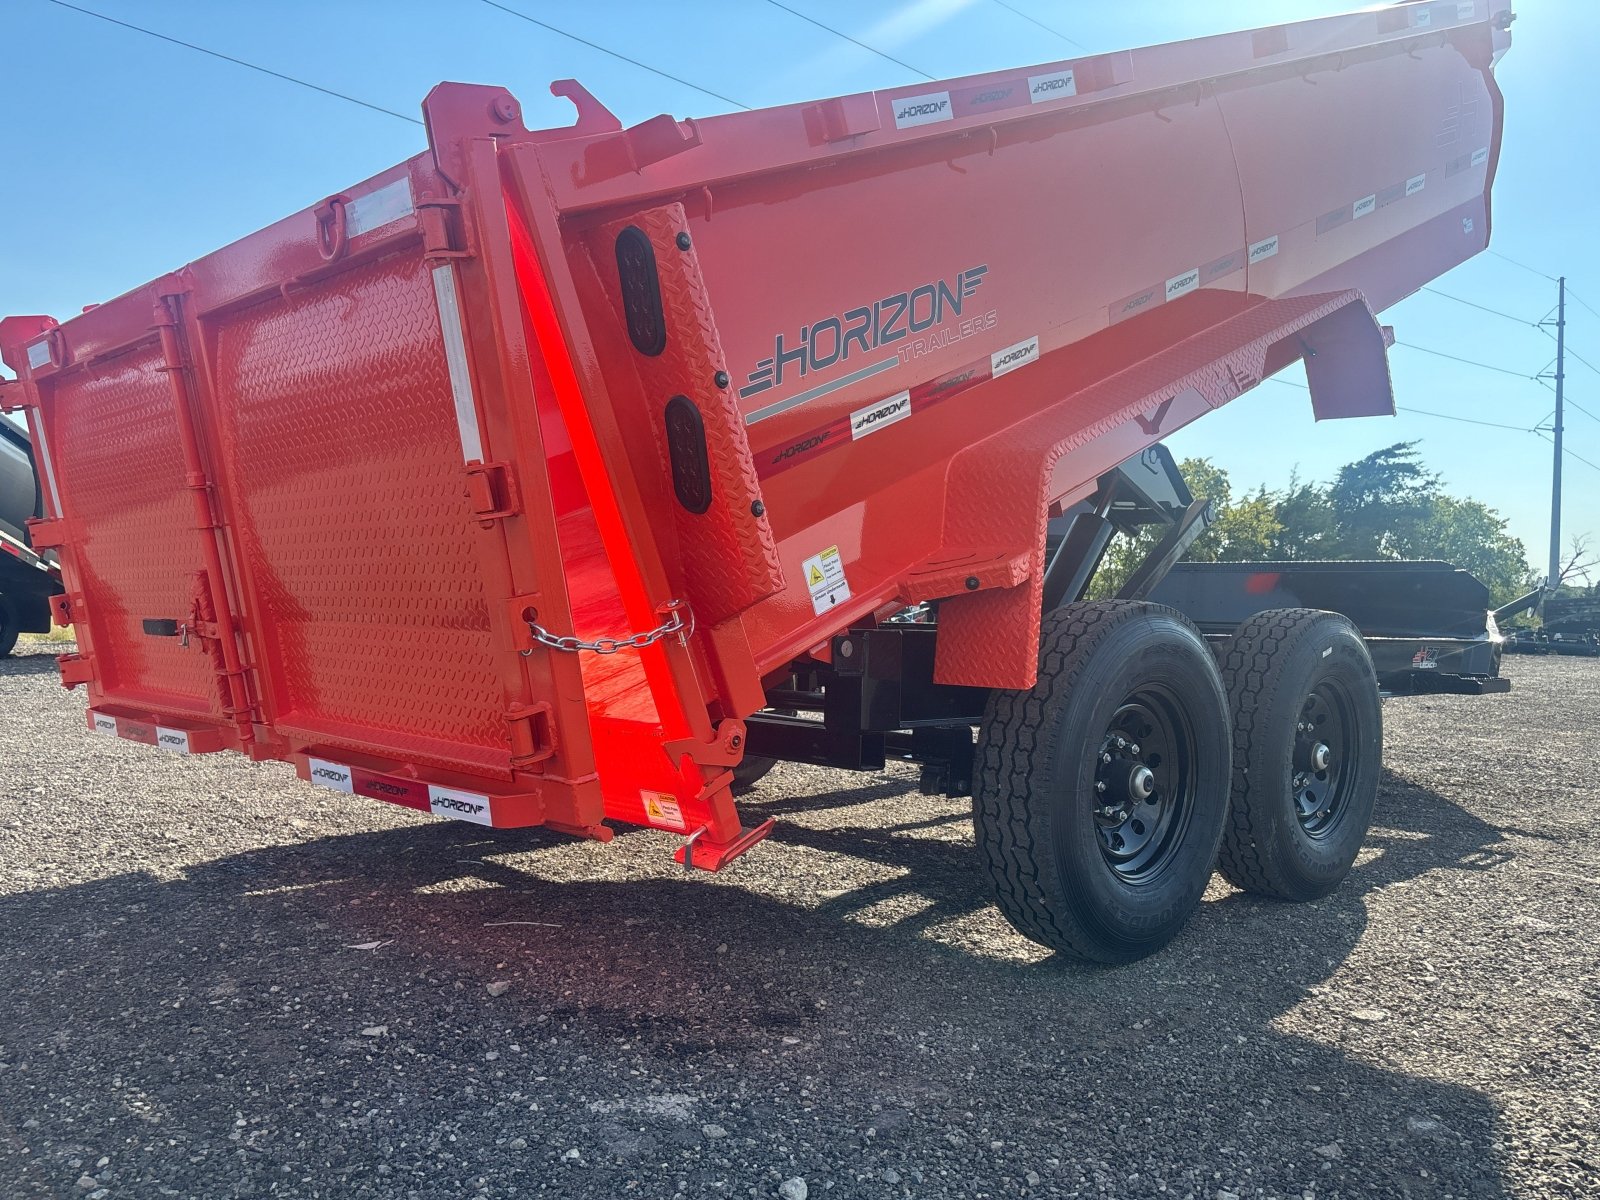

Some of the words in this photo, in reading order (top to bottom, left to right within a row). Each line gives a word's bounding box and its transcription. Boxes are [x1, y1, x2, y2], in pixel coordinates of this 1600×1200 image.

[1033, 77, 1071, 93] HORIZON
[899, 101, 946, 118] HORIZON
[755, 266, 978, 394] HORIZON
[898, 310, 998, 362] TRAILERS
[995, 343, 1035, 368] HORIZON
[857, 399, 907, 429] HORIZON
[772, 431, 829, 463] HORIZON
[313, 767, 348, 782] HORIZON
[367, 780, 408, 796] HORIZON
[432, 796, 483, 814] HORIZON
